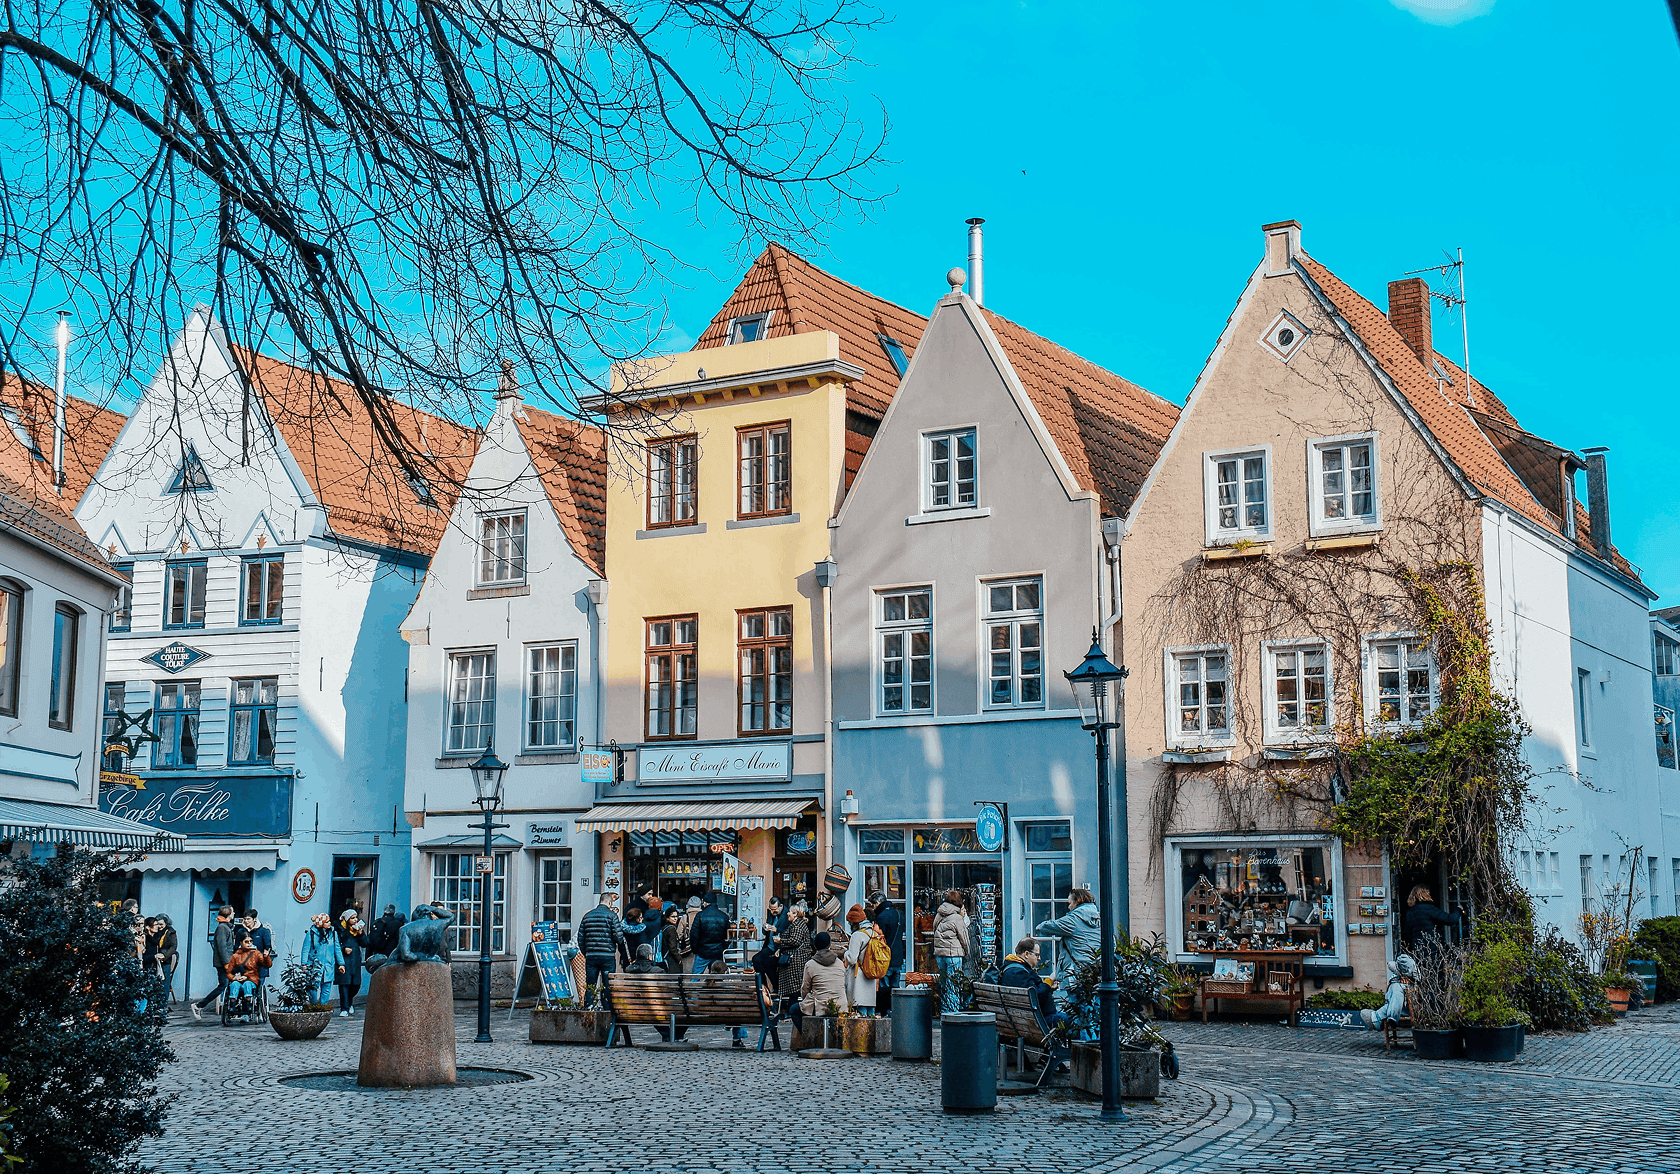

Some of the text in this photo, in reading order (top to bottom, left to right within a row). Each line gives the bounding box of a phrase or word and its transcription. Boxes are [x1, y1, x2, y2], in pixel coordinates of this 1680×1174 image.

[160, 653, 190, 661] COUTURE
[583, 754, 600, 770] EIS
[645, 750, 782, 777] Mini Eiscafé Mario
[107, 780, 231, 823] Café Tölke
[529, 823, 563, 833] Bernstein
[530, 834, 562, 845] Zimmer
[927, 832, 951, 852] Die
[722, 884, 737, 896] EIS
